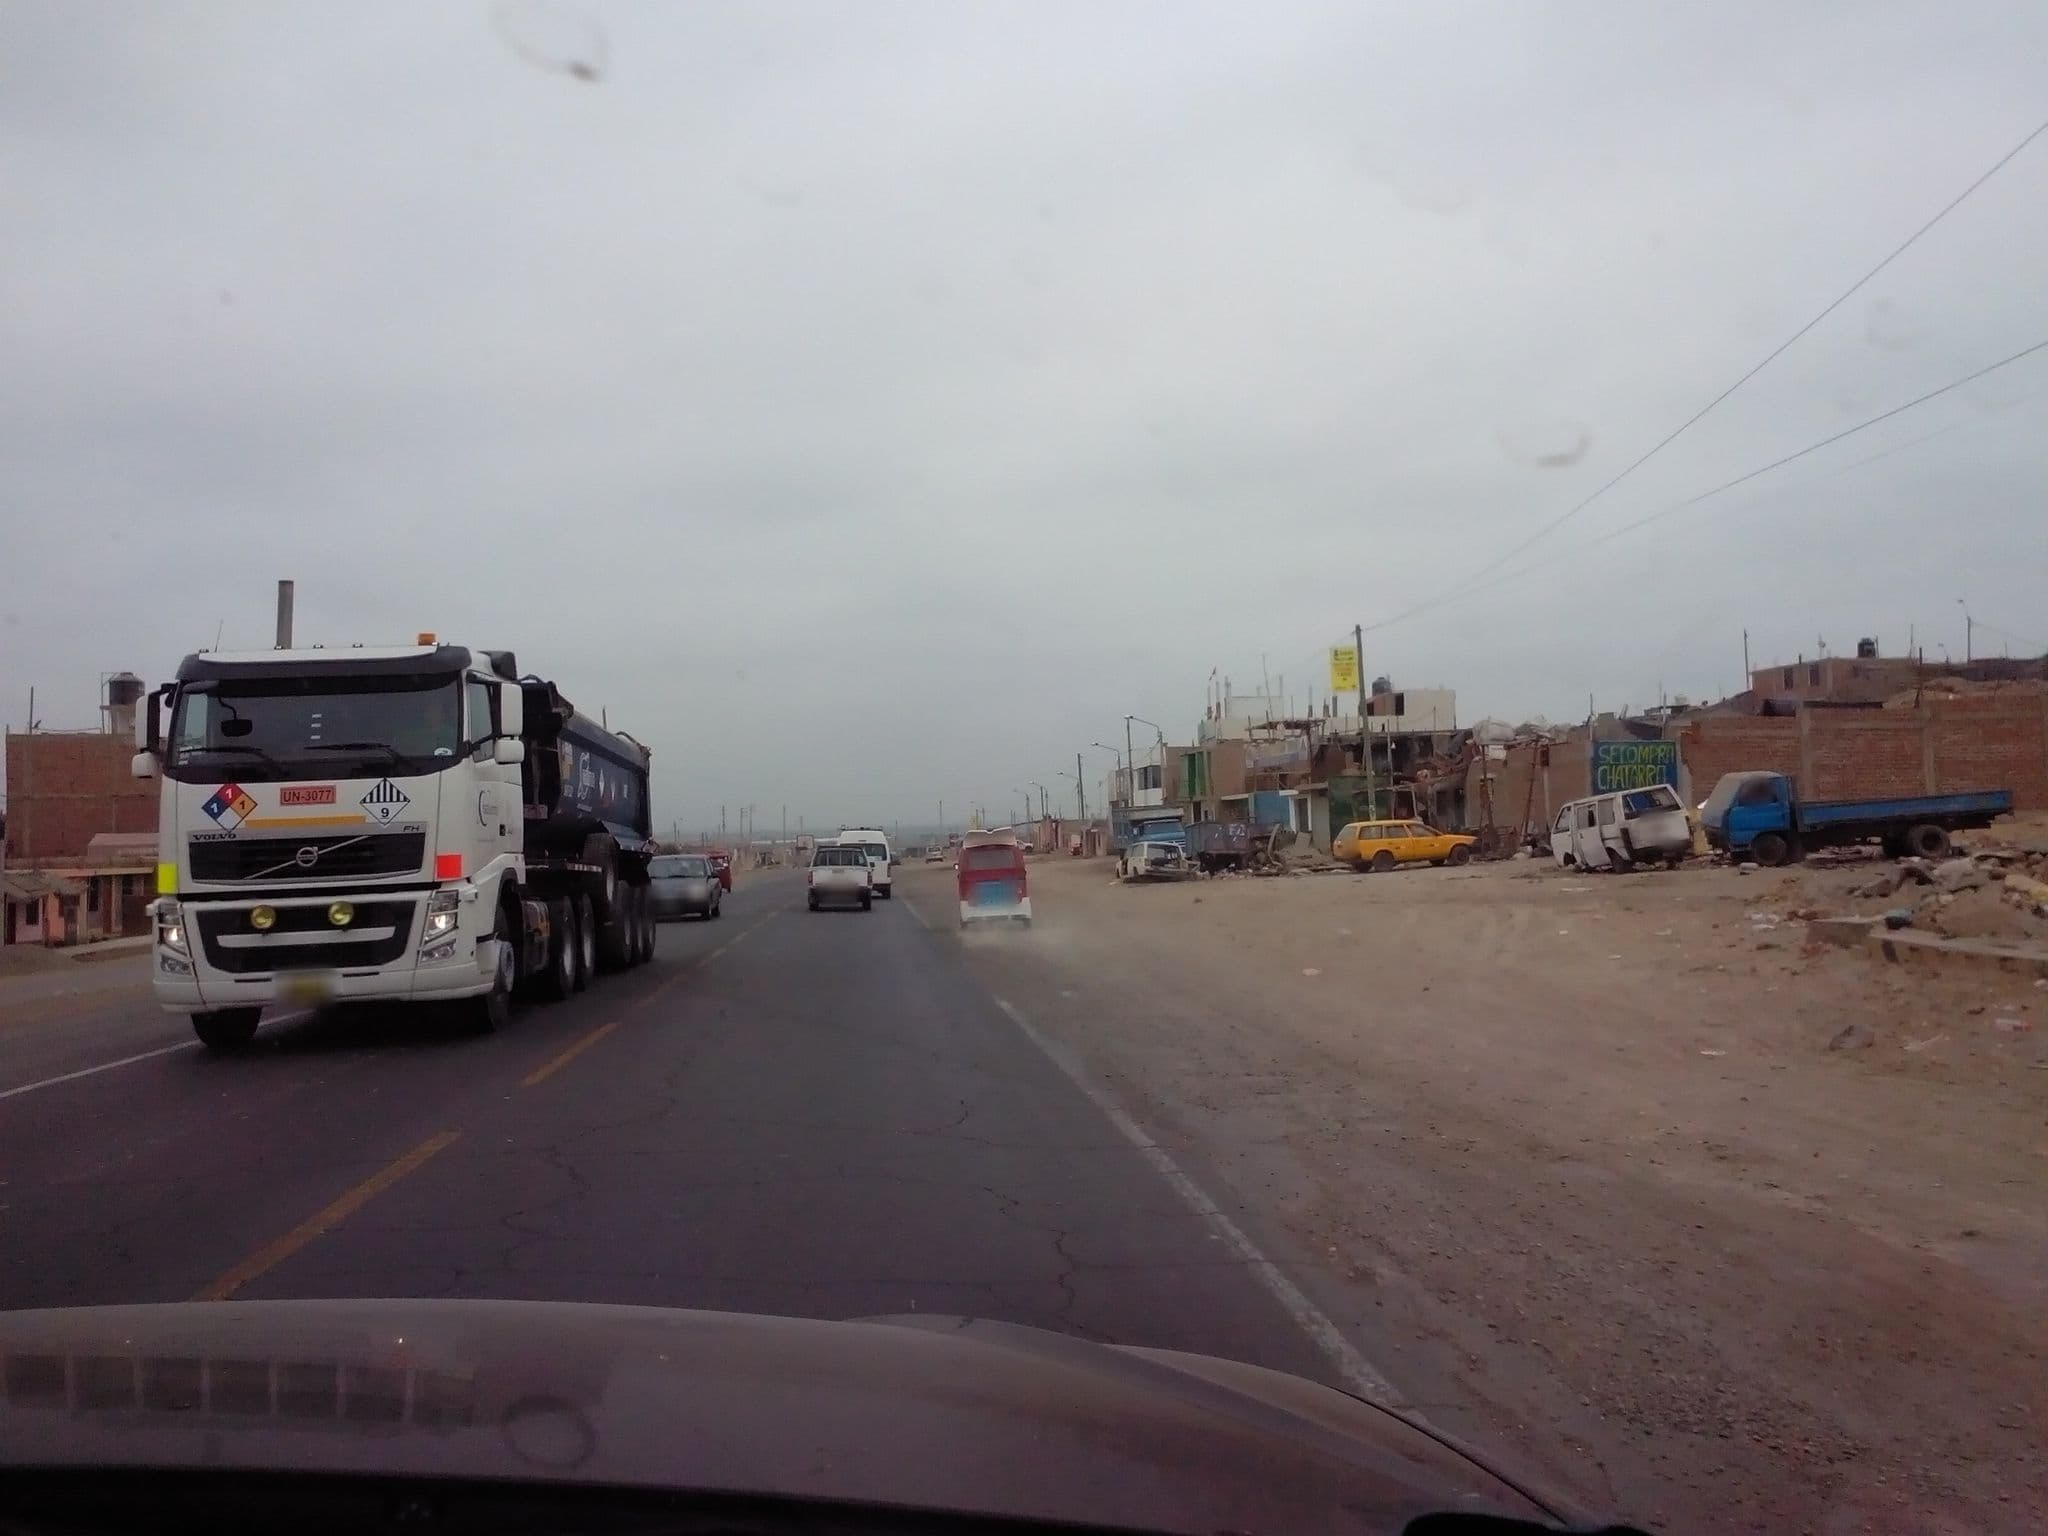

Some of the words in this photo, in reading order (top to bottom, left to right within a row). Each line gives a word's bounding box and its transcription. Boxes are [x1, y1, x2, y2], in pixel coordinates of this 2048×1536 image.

[226, 788, 233, 799] 1
[283, 789, 332, 803] UN-3077
[210, 802, 218, 813] 1
[239, 800, 246, 810] 1
[380, 807, 390, 818] 9
[402, 825, 420, 833] FH
[192, 833, 237, 841] VOLVO
